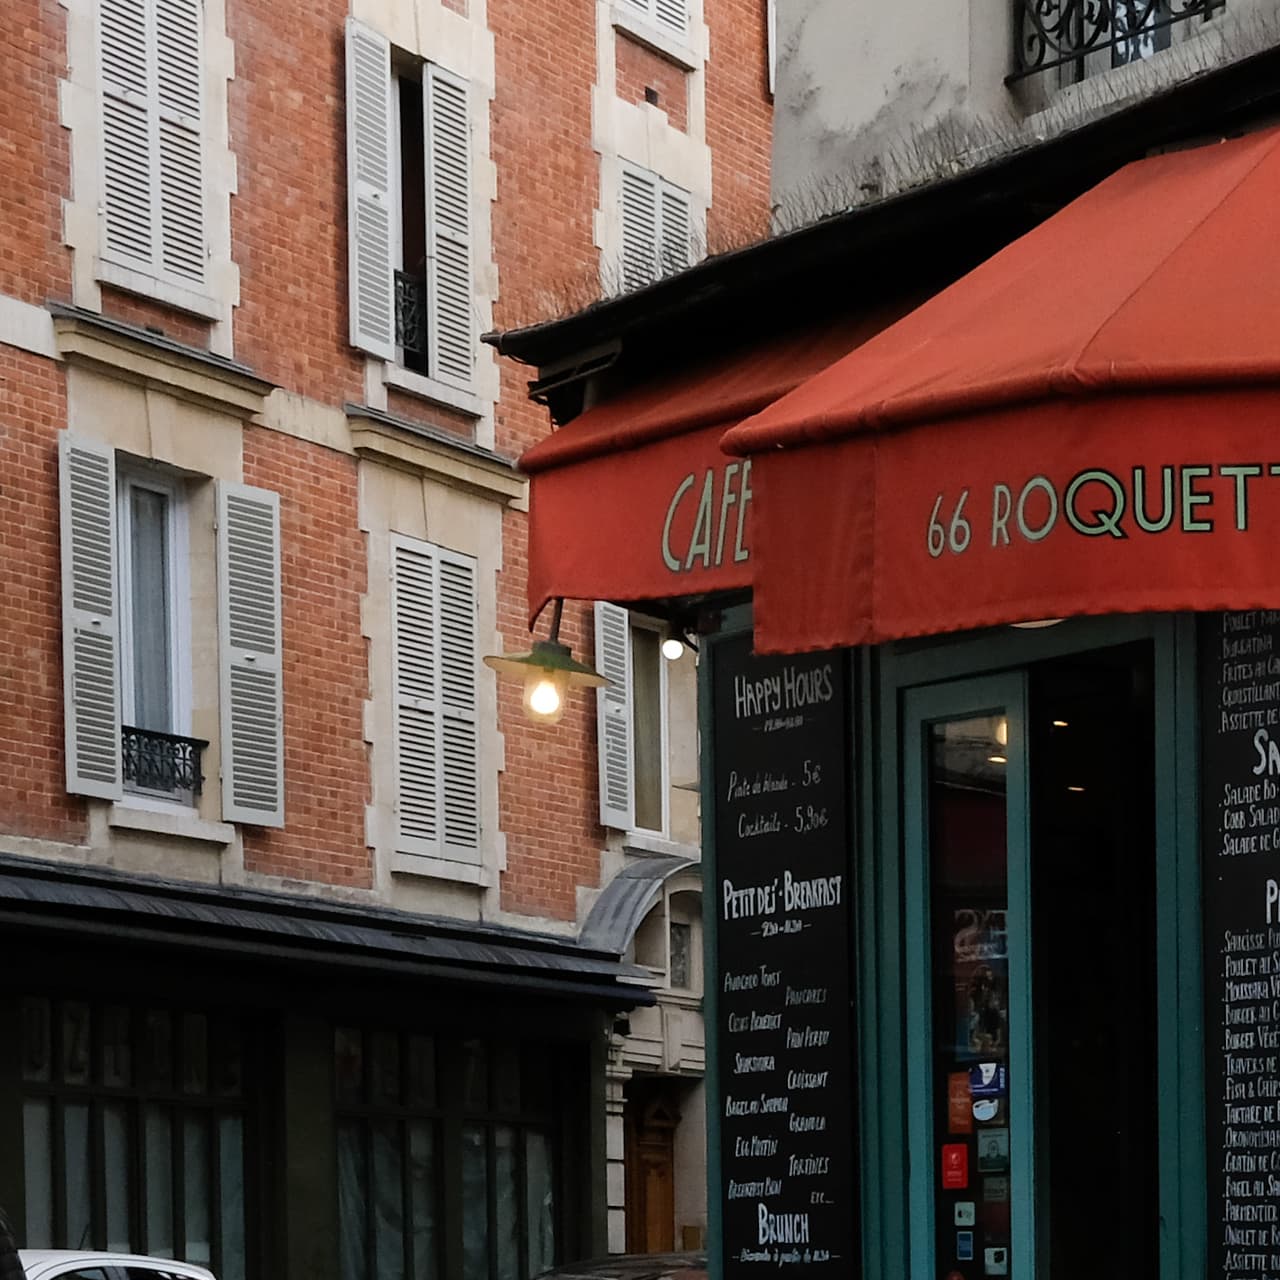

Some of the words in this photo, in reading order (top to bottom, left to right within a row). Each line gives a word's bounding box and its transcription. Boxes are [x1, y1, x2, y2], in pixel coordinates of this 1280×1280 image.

[927, 490, 972, 560] 66
[734, 675, 781, 719] HAPPY
[783, 664, 833, 710] HOURS
[1223, 783, 1261, 806] SALADE
[1249, 804, 1280, 828] SALAD
[1222, 833, 1257, 856] SALADE
[723, 879, 755, 920] PETIT
[783, 870, 842, 912] BREAKFAST
[1225, 955, 1257, 978] POULET
[757, 1202, 811, 1246] BRUNCH
